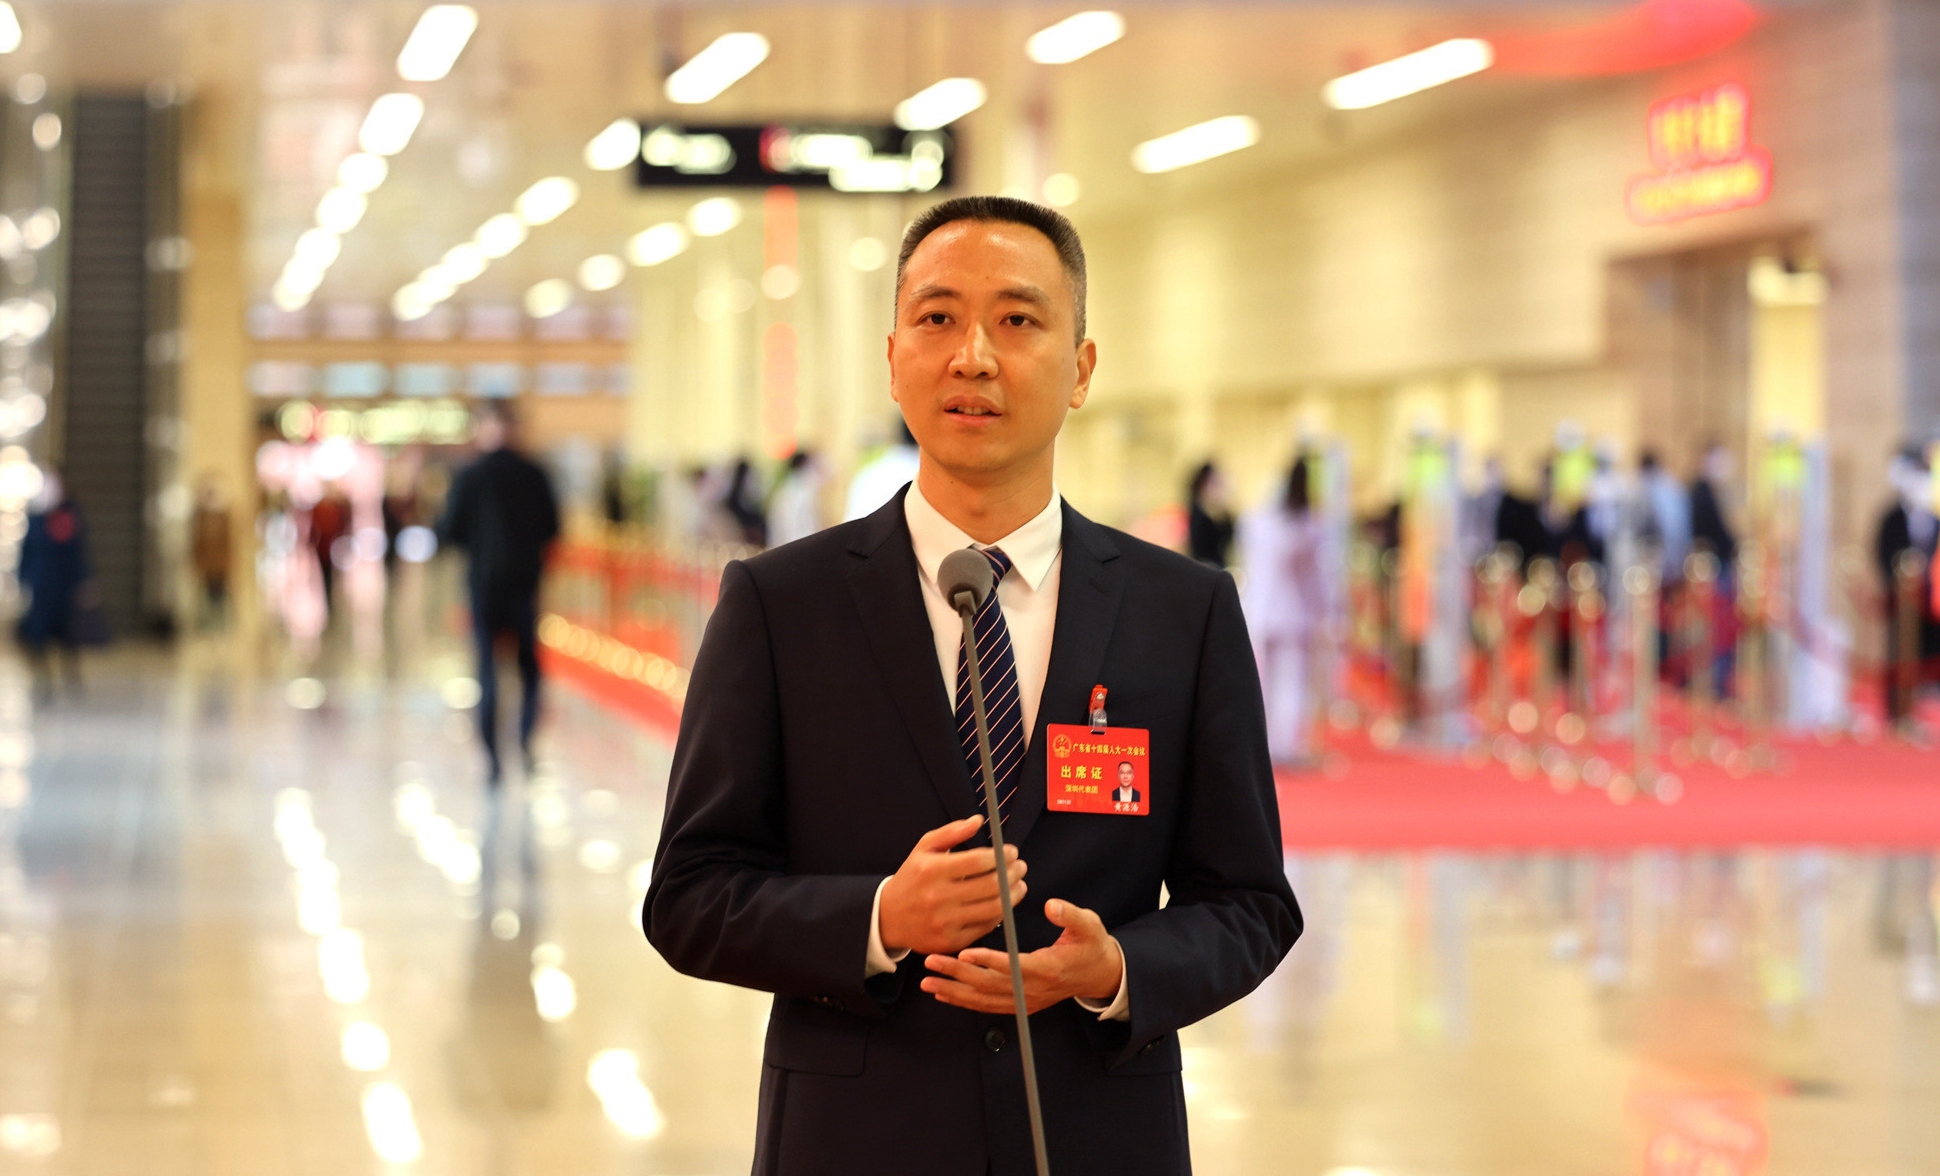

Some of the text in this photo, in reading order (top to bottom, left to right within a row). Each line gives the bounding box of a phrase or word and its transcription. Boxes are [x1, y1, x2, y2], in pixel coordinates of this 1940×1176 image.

[1060, 764, 1103, 780] 出席证
[1065, 784, 1099, 794] 深圳代表团
